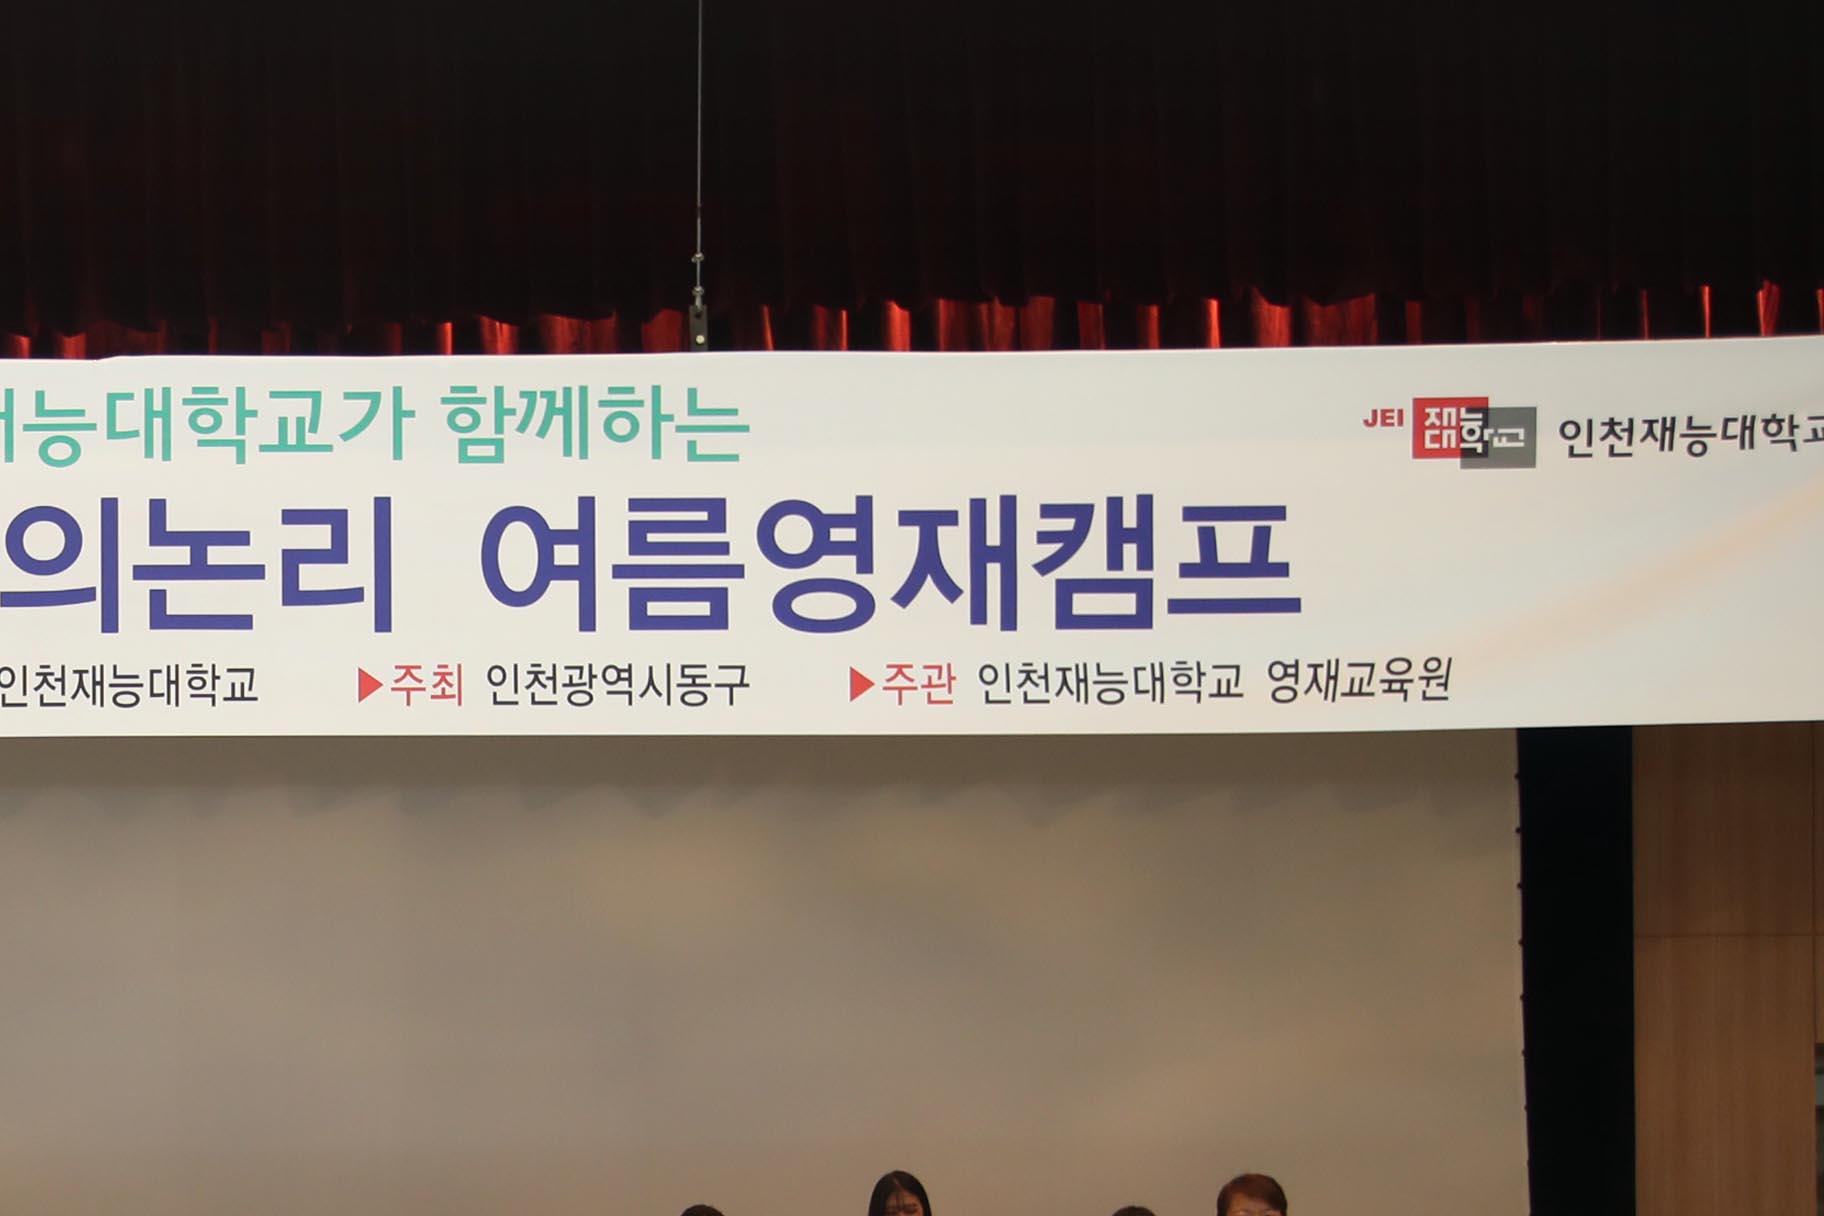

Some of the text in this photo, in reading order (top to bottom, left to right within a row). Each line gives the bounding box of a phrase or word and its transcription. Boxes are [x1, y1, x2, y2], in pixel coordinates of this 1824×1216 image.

[441, 385, 750, 464] 함께하는
[1363, 409, 1404, 427] JEI
[481, 494, 1301, 633] 여름영재캠프
[391, 663, 750, 707] 주최 인천광역시동구
[883, 657, 1452, 706] 주관 인천재능대학교 영재교육원
